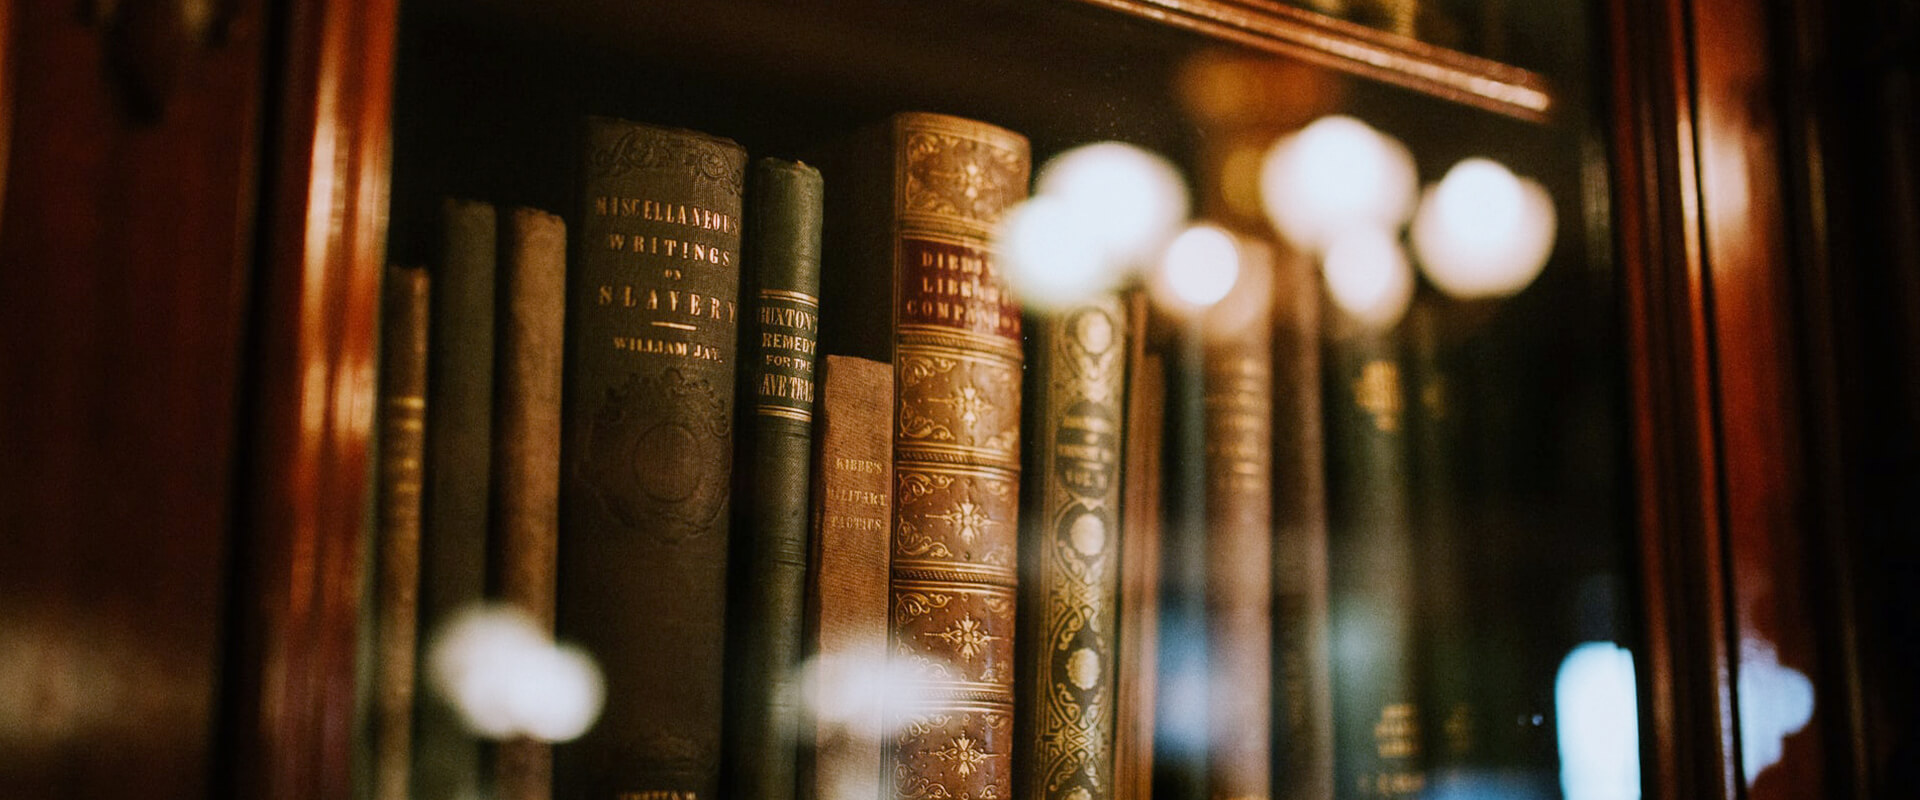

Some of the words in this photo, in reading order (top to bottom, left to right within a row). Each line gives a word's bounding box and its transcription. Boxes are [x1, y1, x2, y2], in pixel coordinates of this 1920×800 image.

[596, 197, 738, 235] MISCELLANEOUS
[609, 234, 730, 266] WRITINGS
[664, 268, 682, 281] ON
[600, 285, 737, 323] SLAVERY
[906, 300, 1020, 335] COMPANION
[614, 336, 688, 357] WILLIAM
[762, 332, 816, 355] REMEDY
[766, 355, 791, 368] FOR
[794, 358, 812, 373] THE
[759, 373, 788, 398] AVE
[790, 376, 815, 403] TRAD
[836, 457, 883, 475] KIBBE'S
[826, 487, 889, 506] MILITARY
[830, 515, 882, 531] TACTICS
